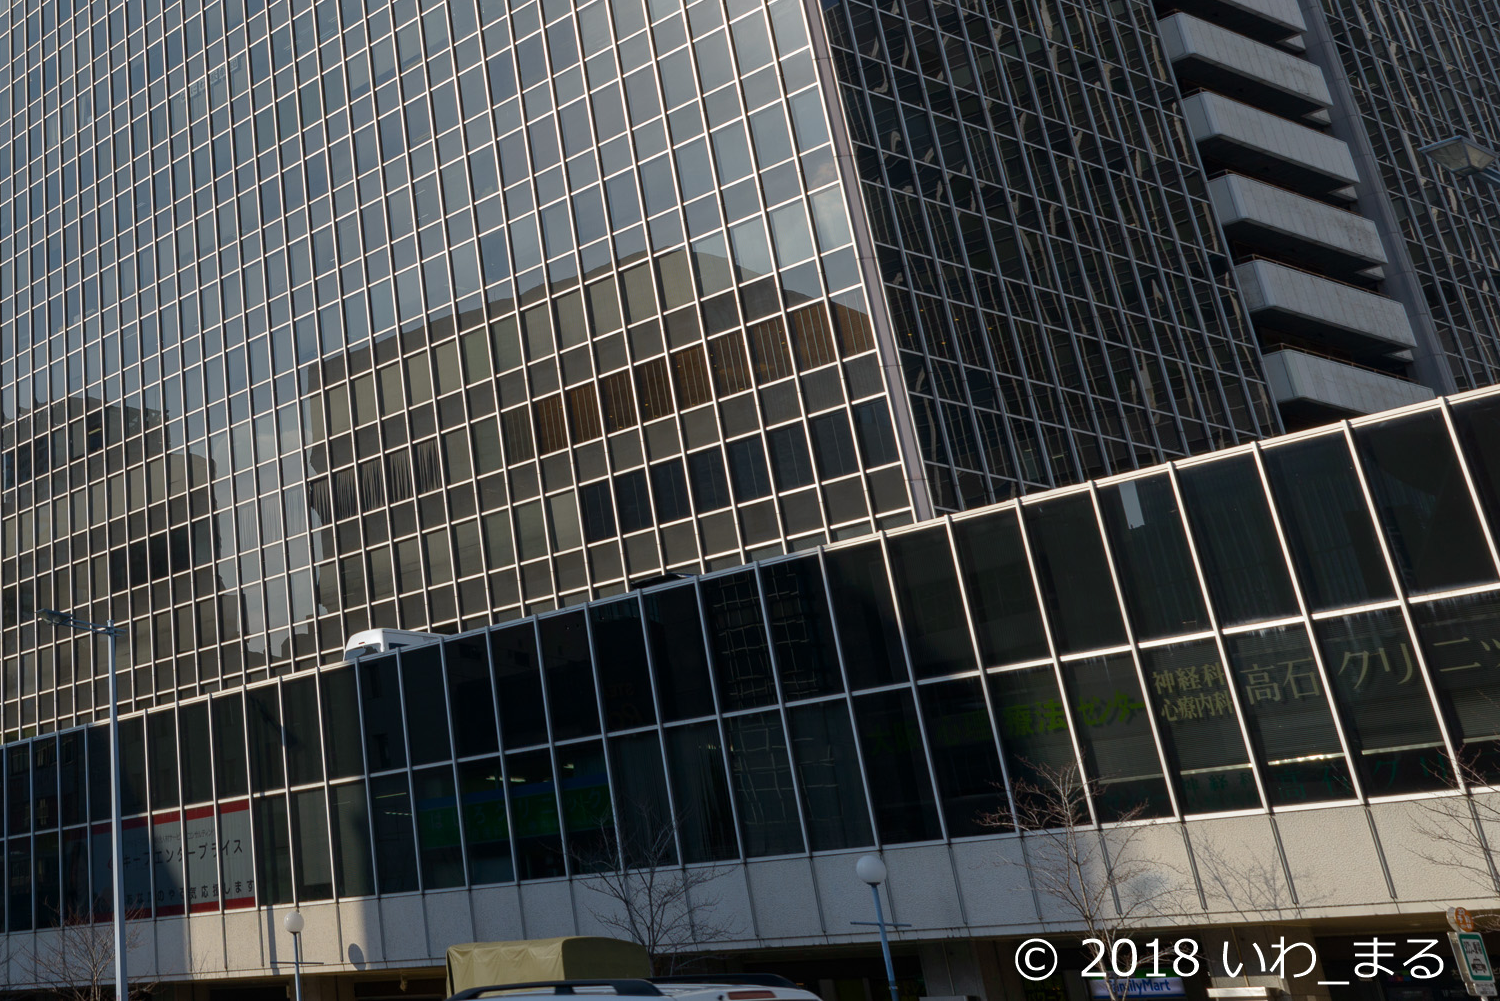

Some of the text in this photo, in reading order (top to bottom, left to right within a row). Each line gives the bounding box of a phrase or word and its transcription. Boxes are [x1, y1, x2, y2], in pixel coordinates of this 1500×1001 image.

[1152, 661, 1226, 696] 神経科
[1160, 688, 1235, 723] 心療内科
